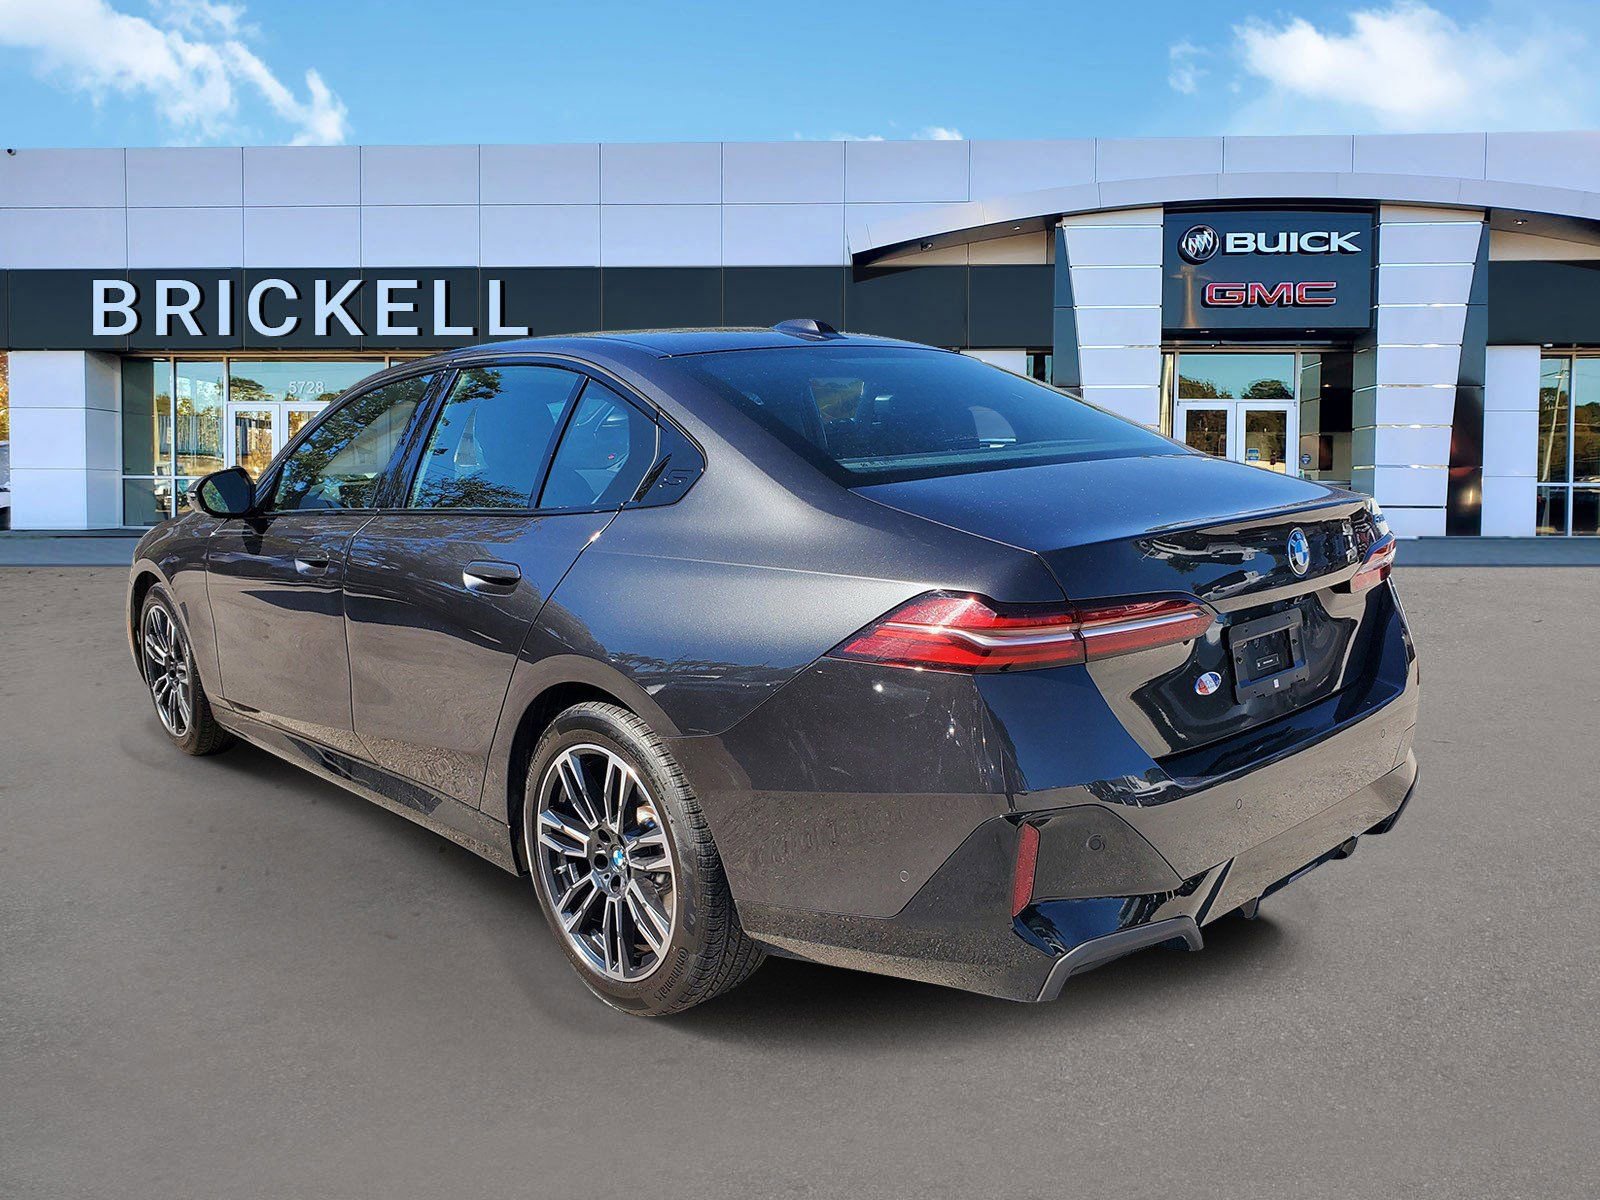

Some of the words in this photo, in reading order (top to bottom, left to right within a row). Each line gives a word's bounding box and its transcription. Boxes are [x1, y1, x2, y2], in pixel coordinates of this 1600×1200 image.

[1225, 231, 1362, 253] BUICK
[1205, 281, 1337, 305] GMC
[91, 278, 530, 337] BRICKELL
[288, 380, 325, 395] 5728
